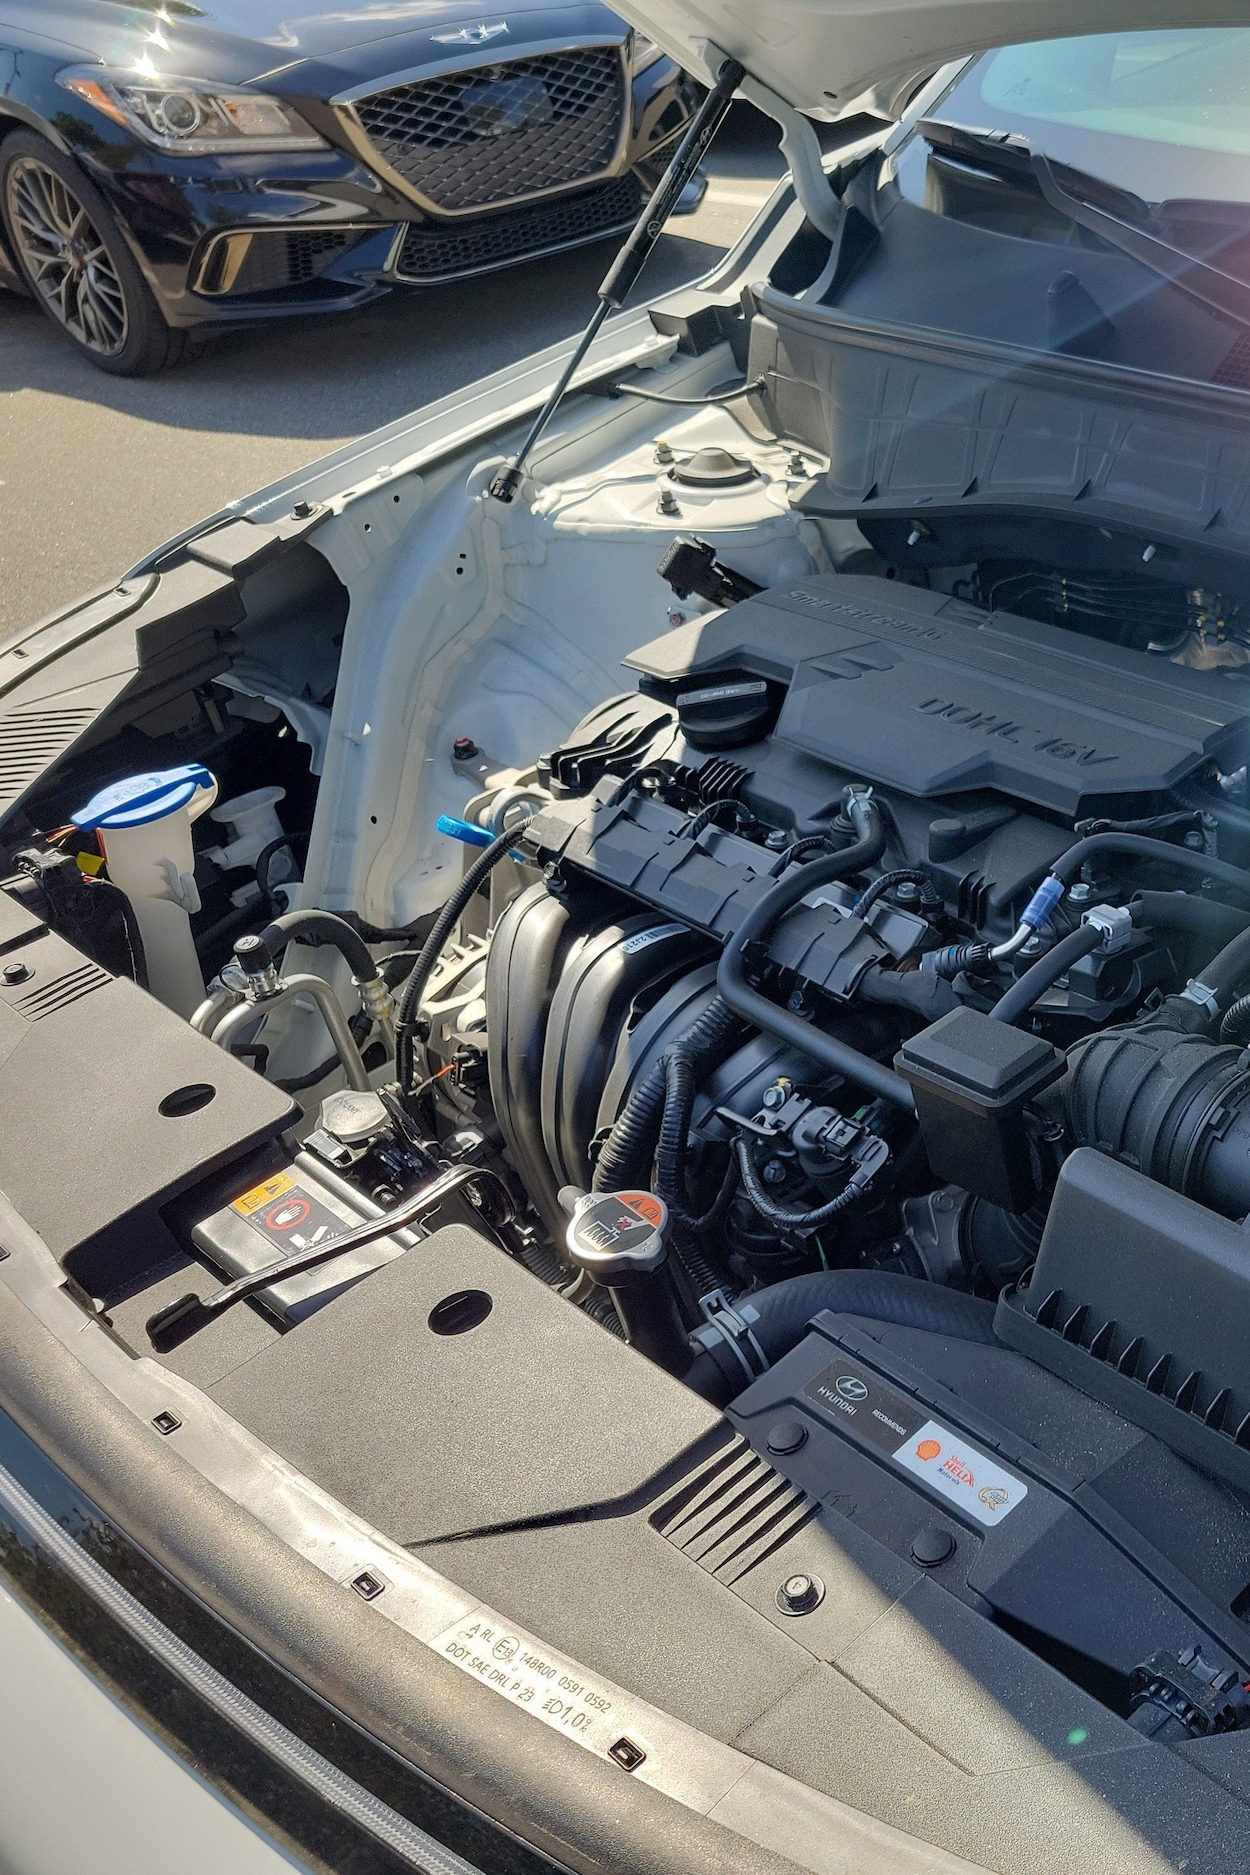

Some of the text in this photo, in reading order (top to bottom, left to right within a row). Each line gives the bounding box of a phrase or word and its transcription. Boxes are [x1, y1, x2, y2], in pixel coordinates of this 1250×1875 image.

[910, 698, 1120, 767] DOHC 16V
[817, 1386, 857, 1416] HYUNDAI
[872, 1409, 907, 1436] RECOMMENDS
[943, 1460, 975, 1487] HELIX
[950, 1455, 967, 1468] Shell
[445, 1642, 534, 1702] DOT SAE DRL P 23
[469, 1623, 481, 1634] A
[480, 1628, 495, 1642] RL
[519, 1652, 557, 1679] 148R00
[558, 1676, 585, 1696] 0591
[584, 1692, 612, 1714] 0592
